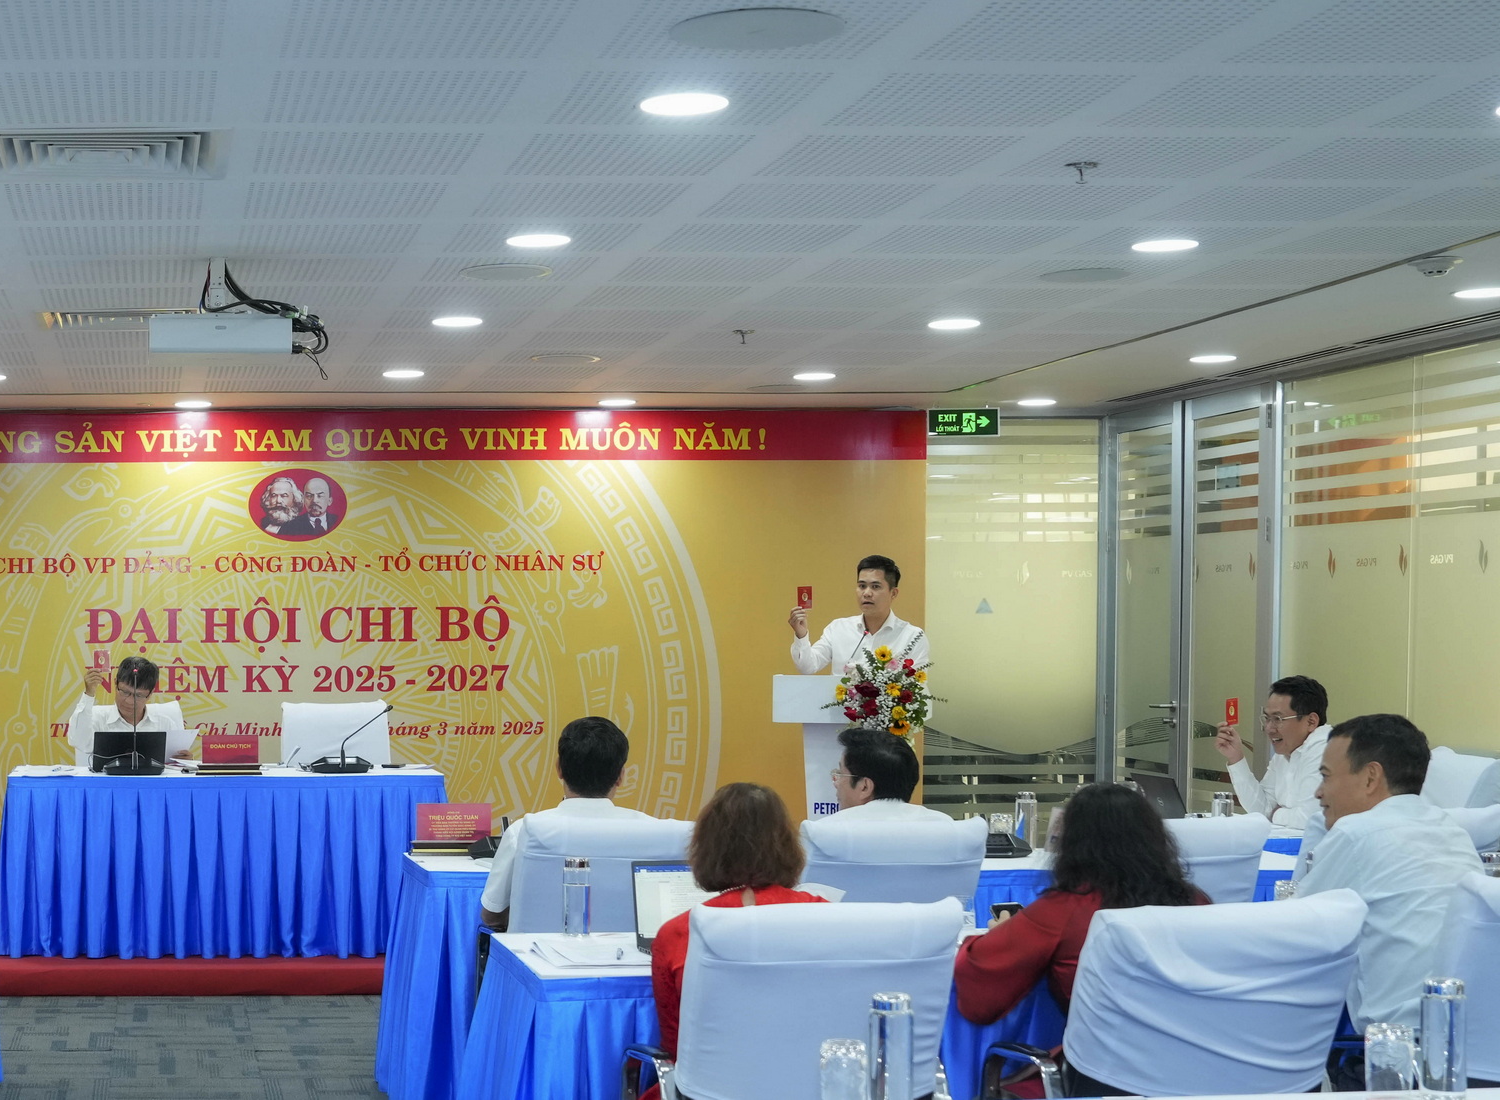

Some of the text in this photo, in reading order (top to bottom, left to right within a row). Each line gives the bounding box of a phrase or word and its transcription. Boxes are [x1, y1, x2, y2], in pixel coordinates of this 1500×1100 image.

[936, 424, 944, 432] LỐI
[938, 414, 957, 422] EXIT
[55, 422, 124, 453] SẢN
[135, 424, 222, 458] VIỆT
[234, 429, 312, 453] NAM
[325, 427, 448, 458] QUANG
[459, 427, 547, 451] VINH
[559, 421, 660, 451] MUÔN
[42, 553, 76, 578] BỘ
[83, 557, 116, 573] VP
[123, 550, 192, 574] ĐẢNG
[214, 552, 282, 573] CÔNG
[290, 551, 357, 573] ĐOÀN
[379, 547, 412, 572] TỔ
[418, 550, 487, 572] CHỨC
[495, 550, 564, 571] NHÂN
[572, 550, 604, 575] SỰ
[85, 595, 510, 653] ĐẠI HỘI CHI BỘ
[242, 656, 300, 693] KỲ
[312, 665, 396, 693] 2025
[427, 664, 510, 692] 2027
[235, 722, 282, 736] Minh
[388, 721, 545, 739] háng 3 năm 2025
